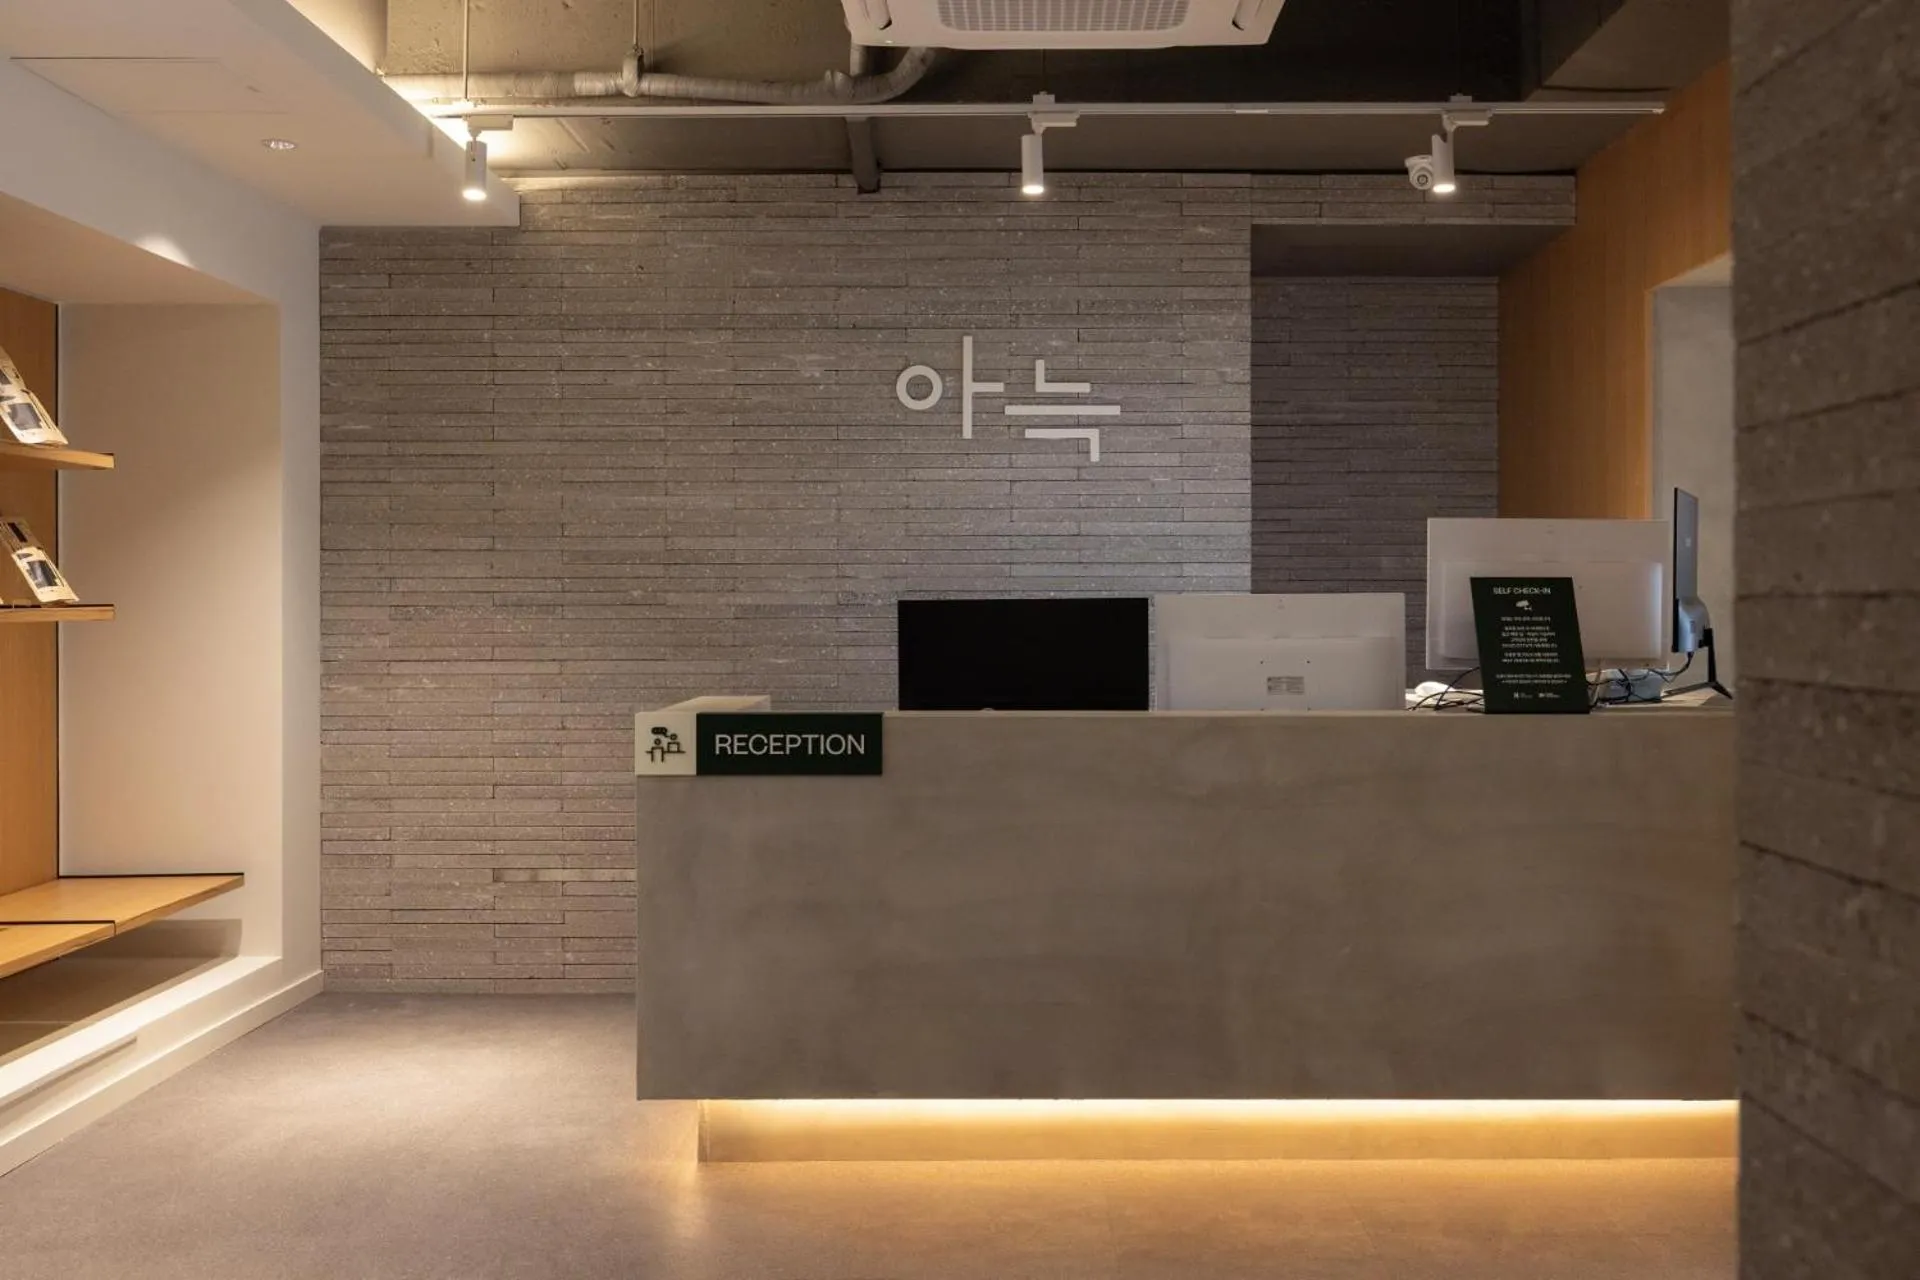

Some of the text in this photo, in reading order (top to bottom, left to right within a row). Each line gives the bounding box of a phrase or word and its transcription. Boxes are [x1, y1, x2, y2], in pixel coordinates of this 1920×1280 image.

[896, 335, 1121, 462] 아늑
[1493, 586, 1551, 595] SELF CHECK-IN
[714, 733, 865, 756] RECEPTION
